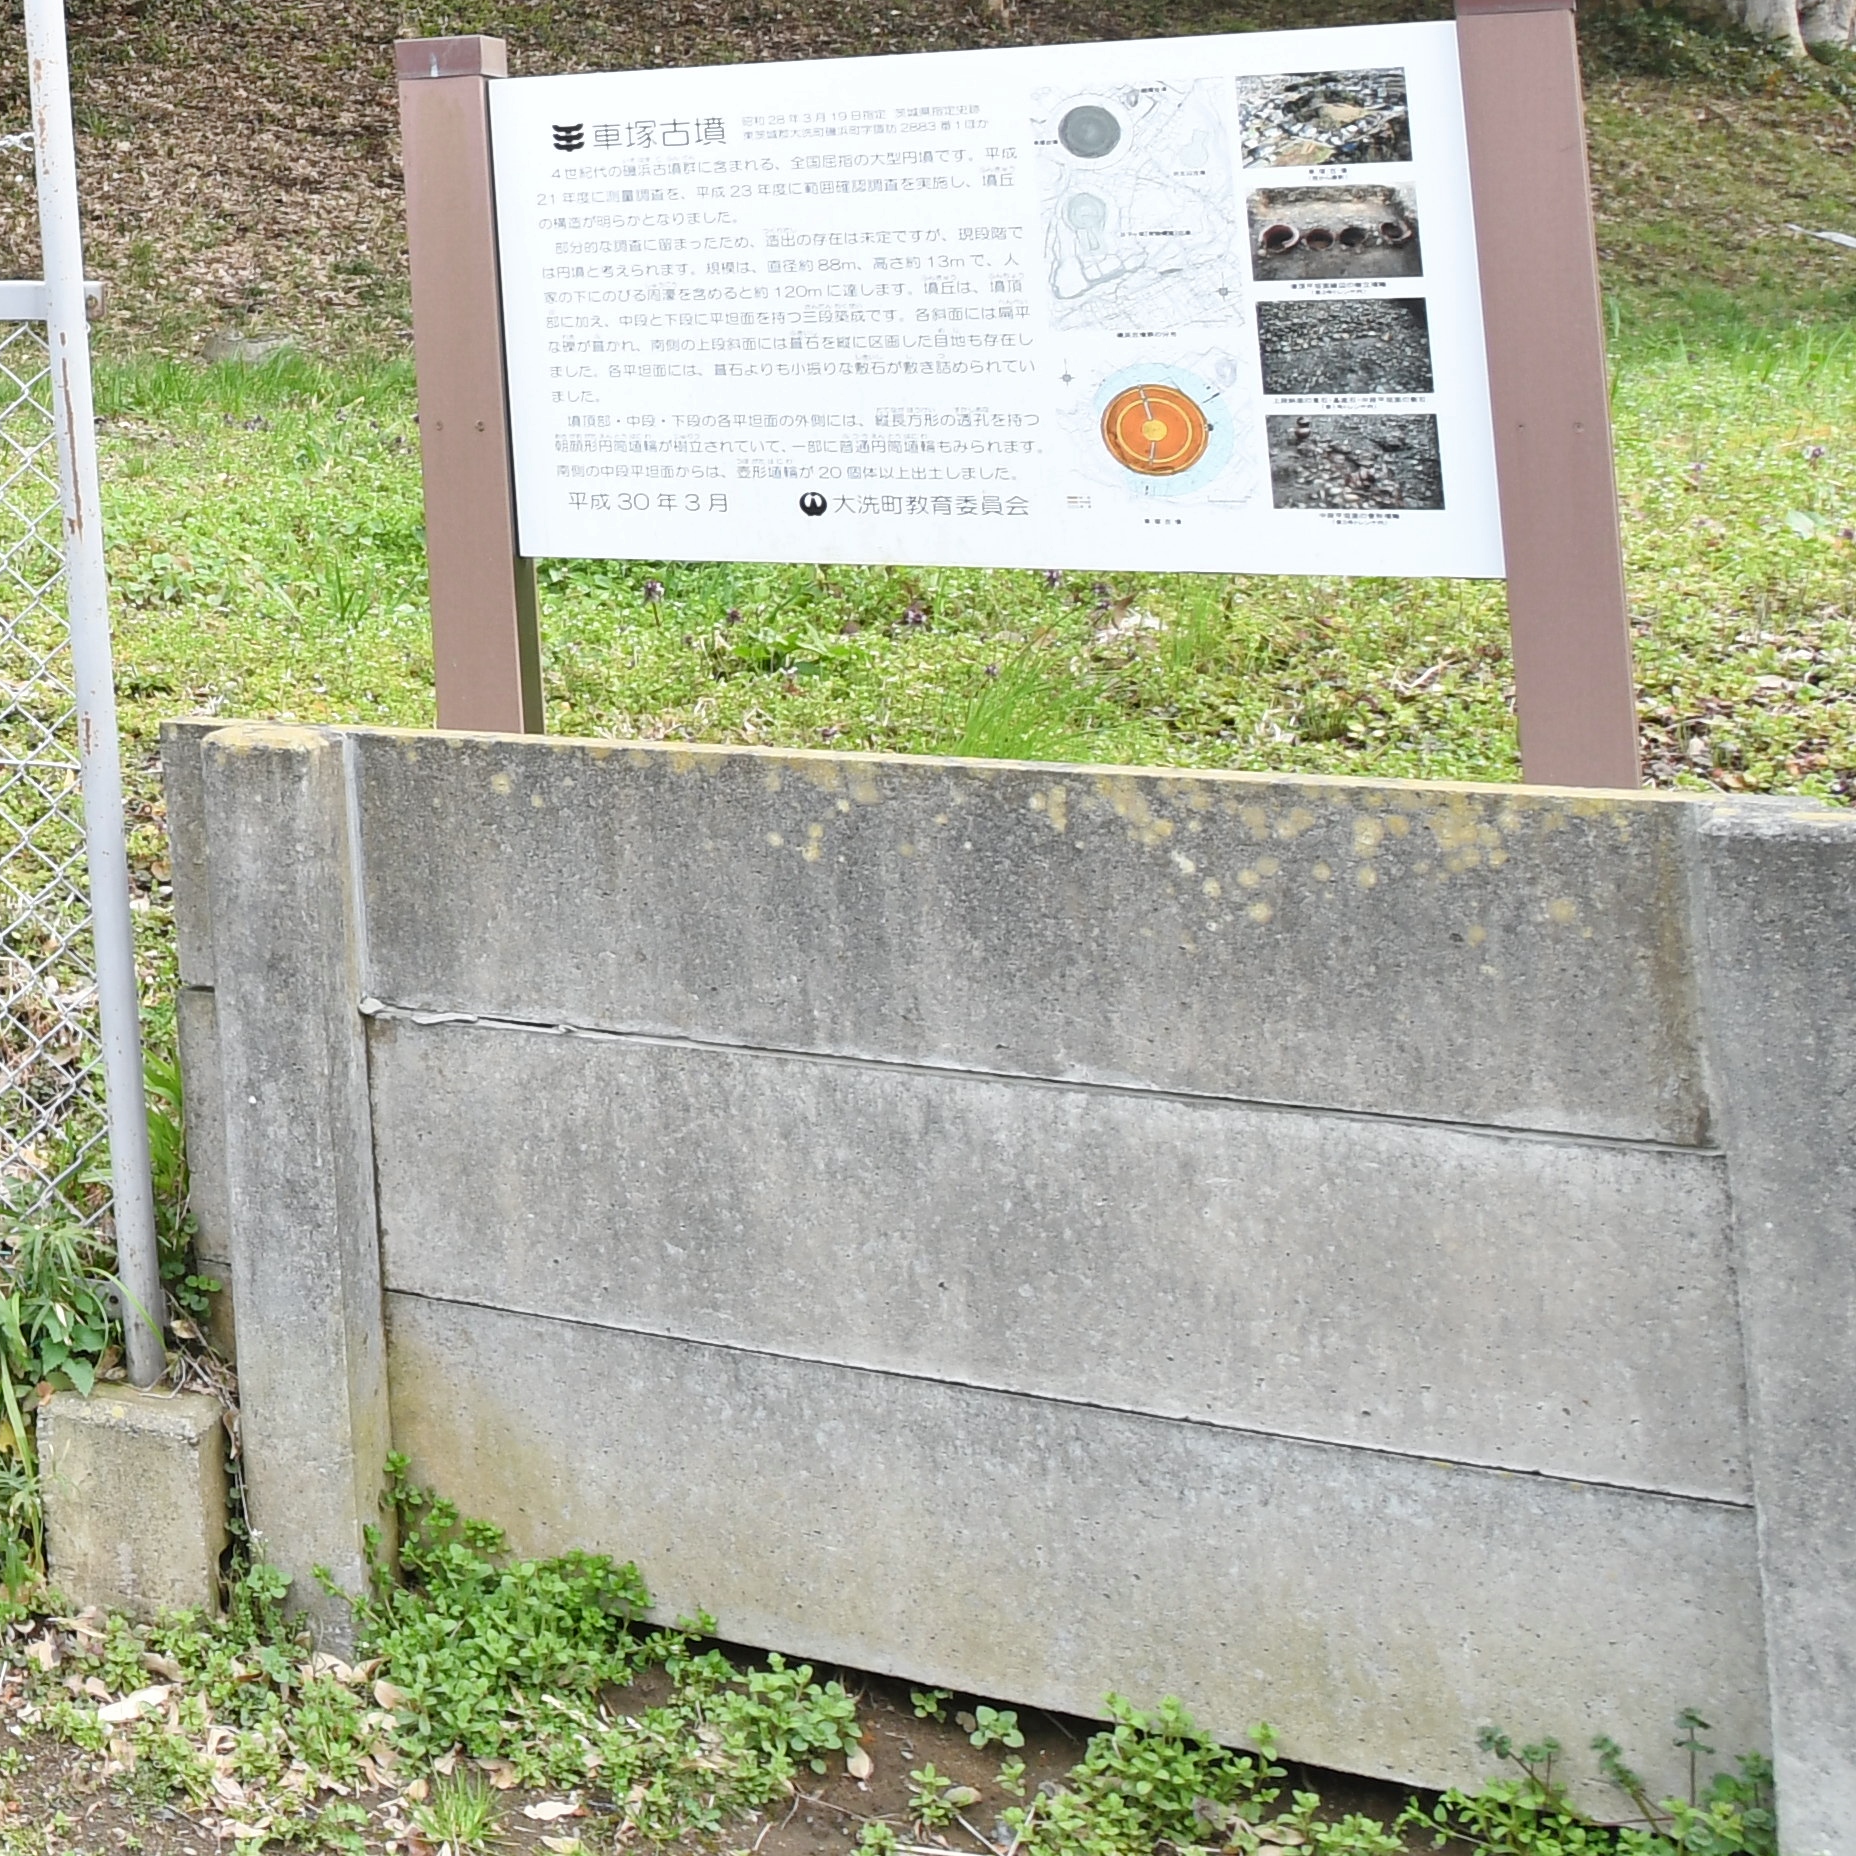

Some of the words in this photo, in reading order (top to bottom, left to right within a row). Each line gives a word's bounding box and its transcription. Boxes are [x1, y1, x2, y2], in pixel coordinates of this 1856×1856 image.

[592, 117, 727, 150] 車塚古墳
[551, 390, 601, 403] ました。
[568, 491, 728, 512] 平成30年3月
[833, 494, 1030, 516] 大洗町教育委員会
